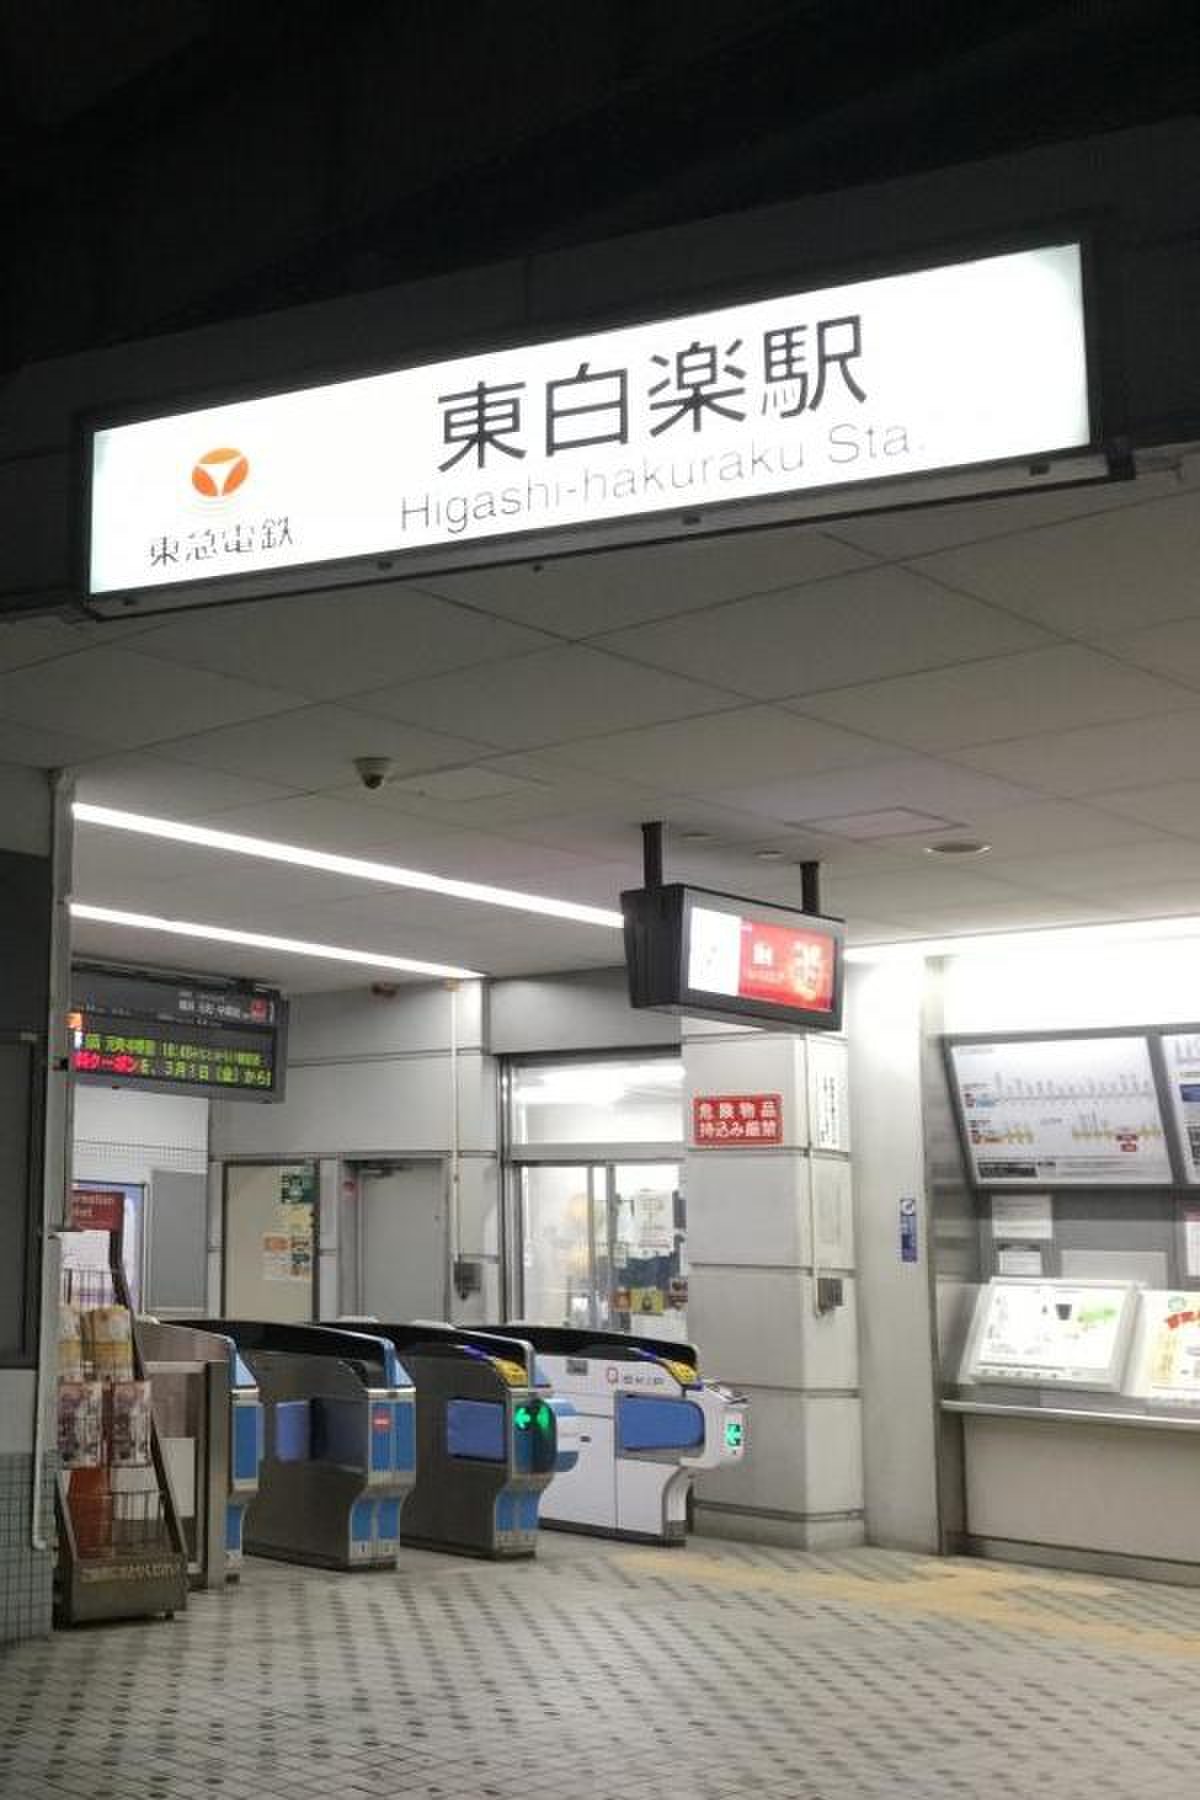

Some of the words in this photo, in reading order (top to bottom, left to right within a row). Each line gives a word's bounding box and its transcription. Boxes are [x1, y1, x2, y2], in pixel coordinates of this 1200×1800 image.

[436, 313, 867, 473] 東白楽駅
[400, 437, 804, 534] Higashi-hakuraku
[827, 423, 925, 465] Sta.
[149, 515, 294, 567] 東急電鉄
